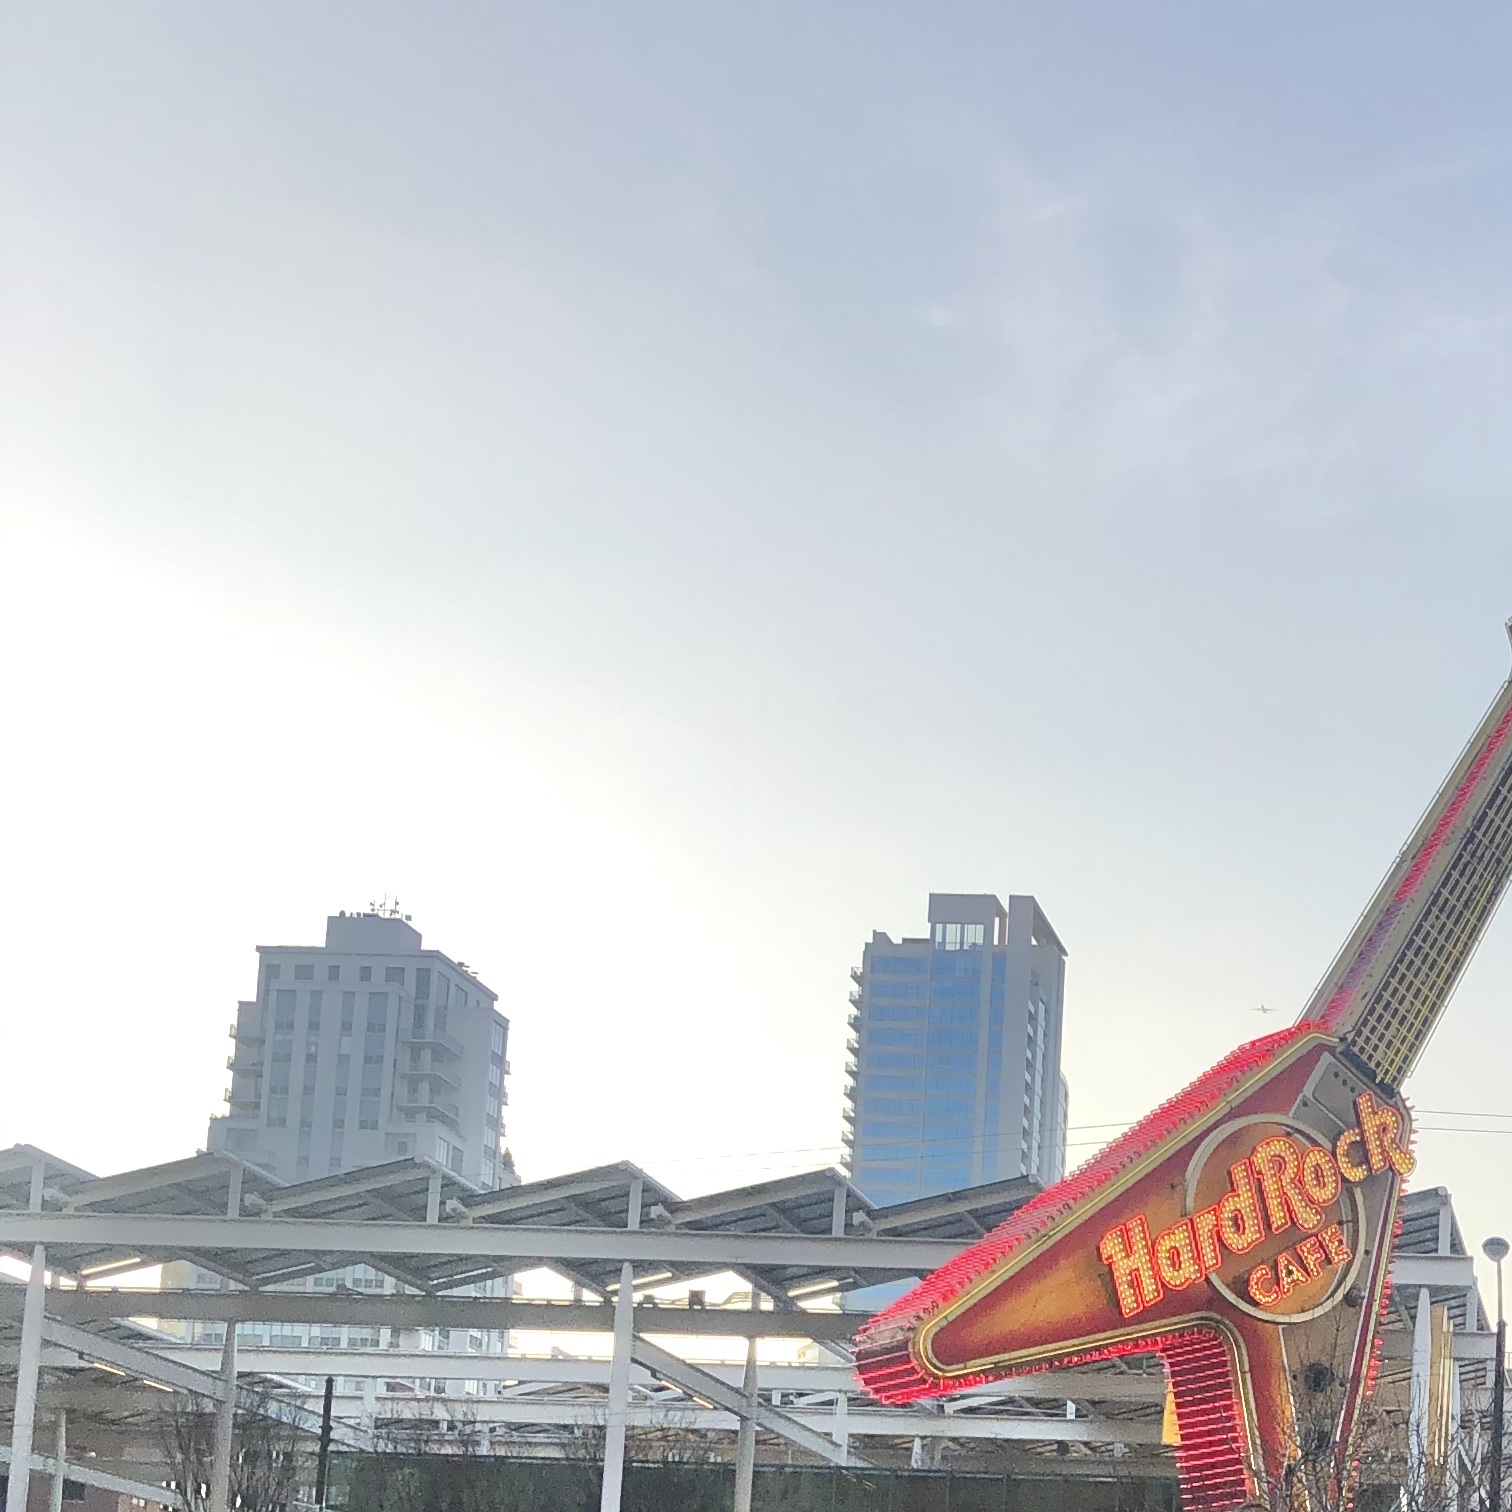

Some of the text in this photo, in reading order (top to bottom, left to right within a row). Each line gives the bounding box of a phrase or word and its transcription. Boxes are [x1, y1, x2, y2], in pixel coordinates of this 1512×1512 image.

[1101, 1091, 1416, 1318] Hard Rock
[1248, 1223, 1354, 1307] CAFE
